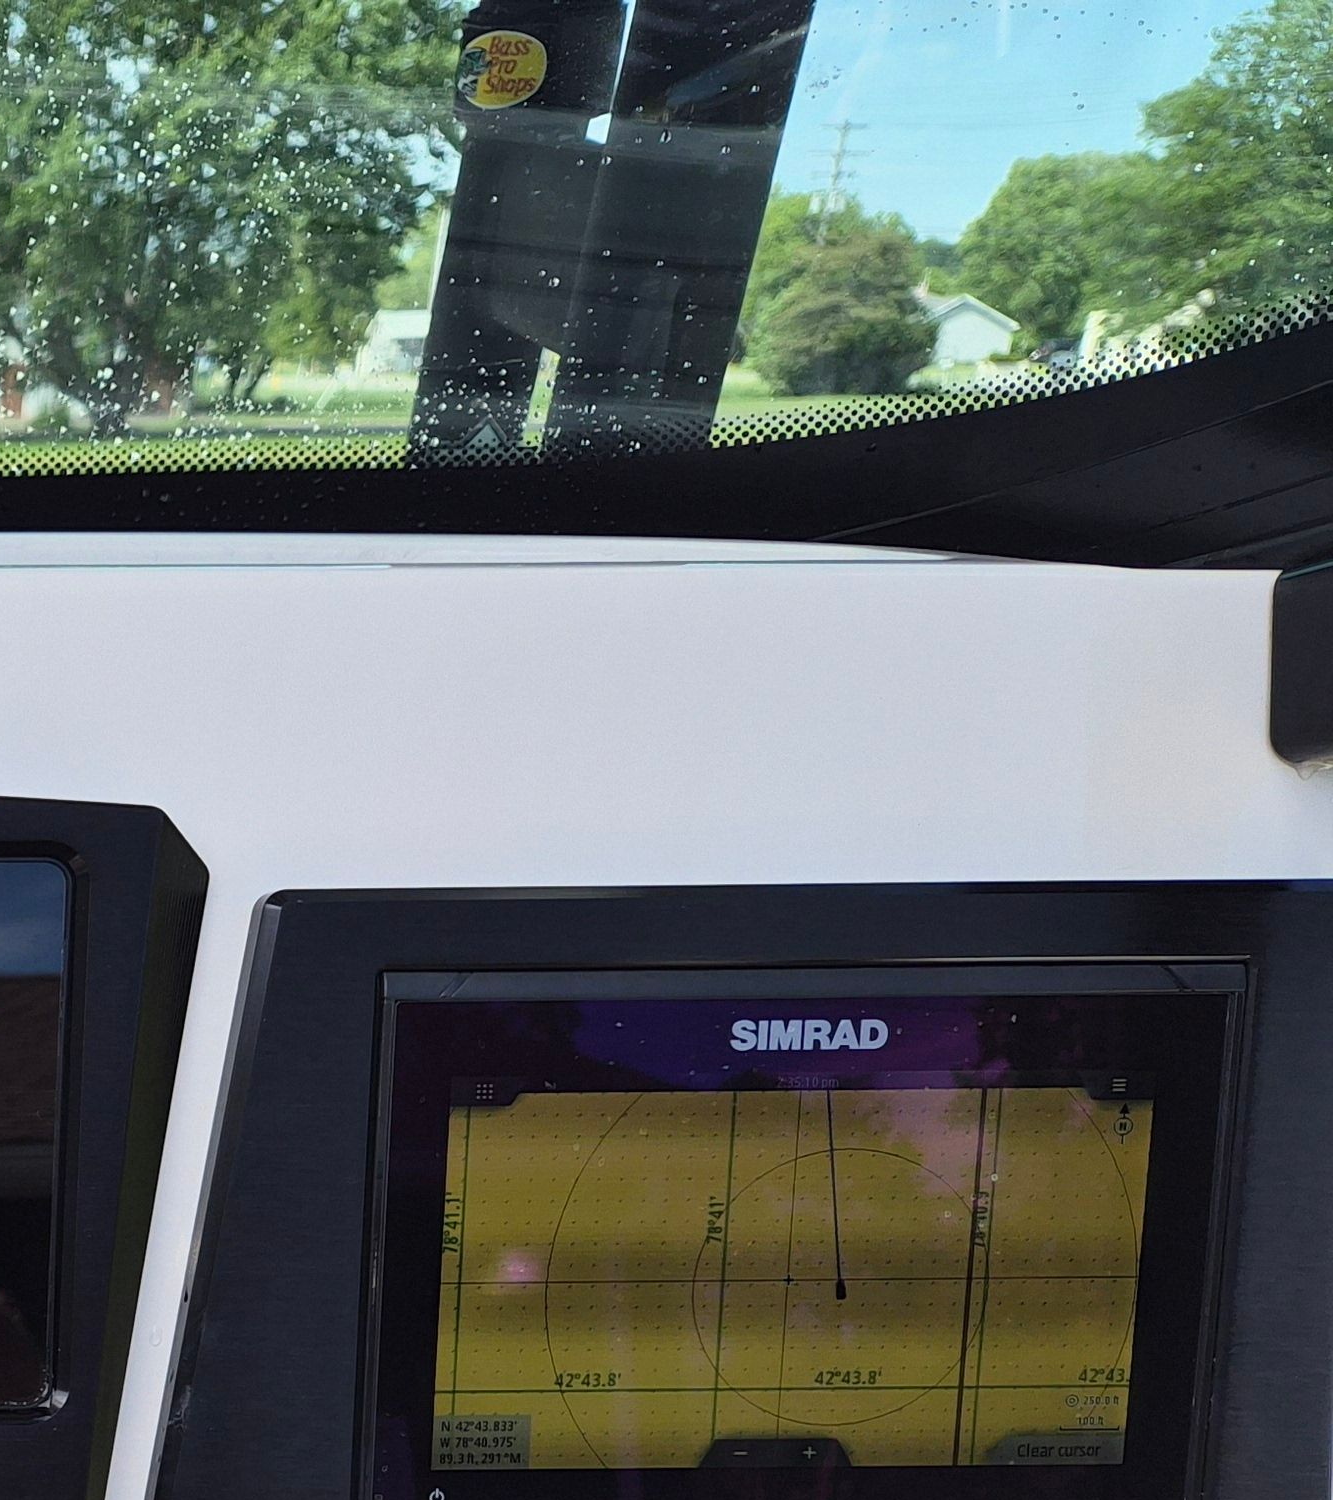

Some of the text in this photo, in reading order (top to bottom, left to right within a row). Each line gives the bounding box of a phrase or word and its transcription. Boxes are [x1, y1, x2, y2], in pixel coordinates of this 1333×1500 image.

[489, 36, 532, 55] Bass
[488, 56, 517, 75] Pro
[483, 76, 536, 97] Shops
[729, 1018, 889, 1052] SIMRAD
[441, 1421, 450, 1431] N
[1078, 1416, 1095, 1425] 100
[439, 1438, 450, 1448] W
[1017, 1443, 1102, 1458] Clear cursor
[439, 1453, 465, 1464] 89.3
